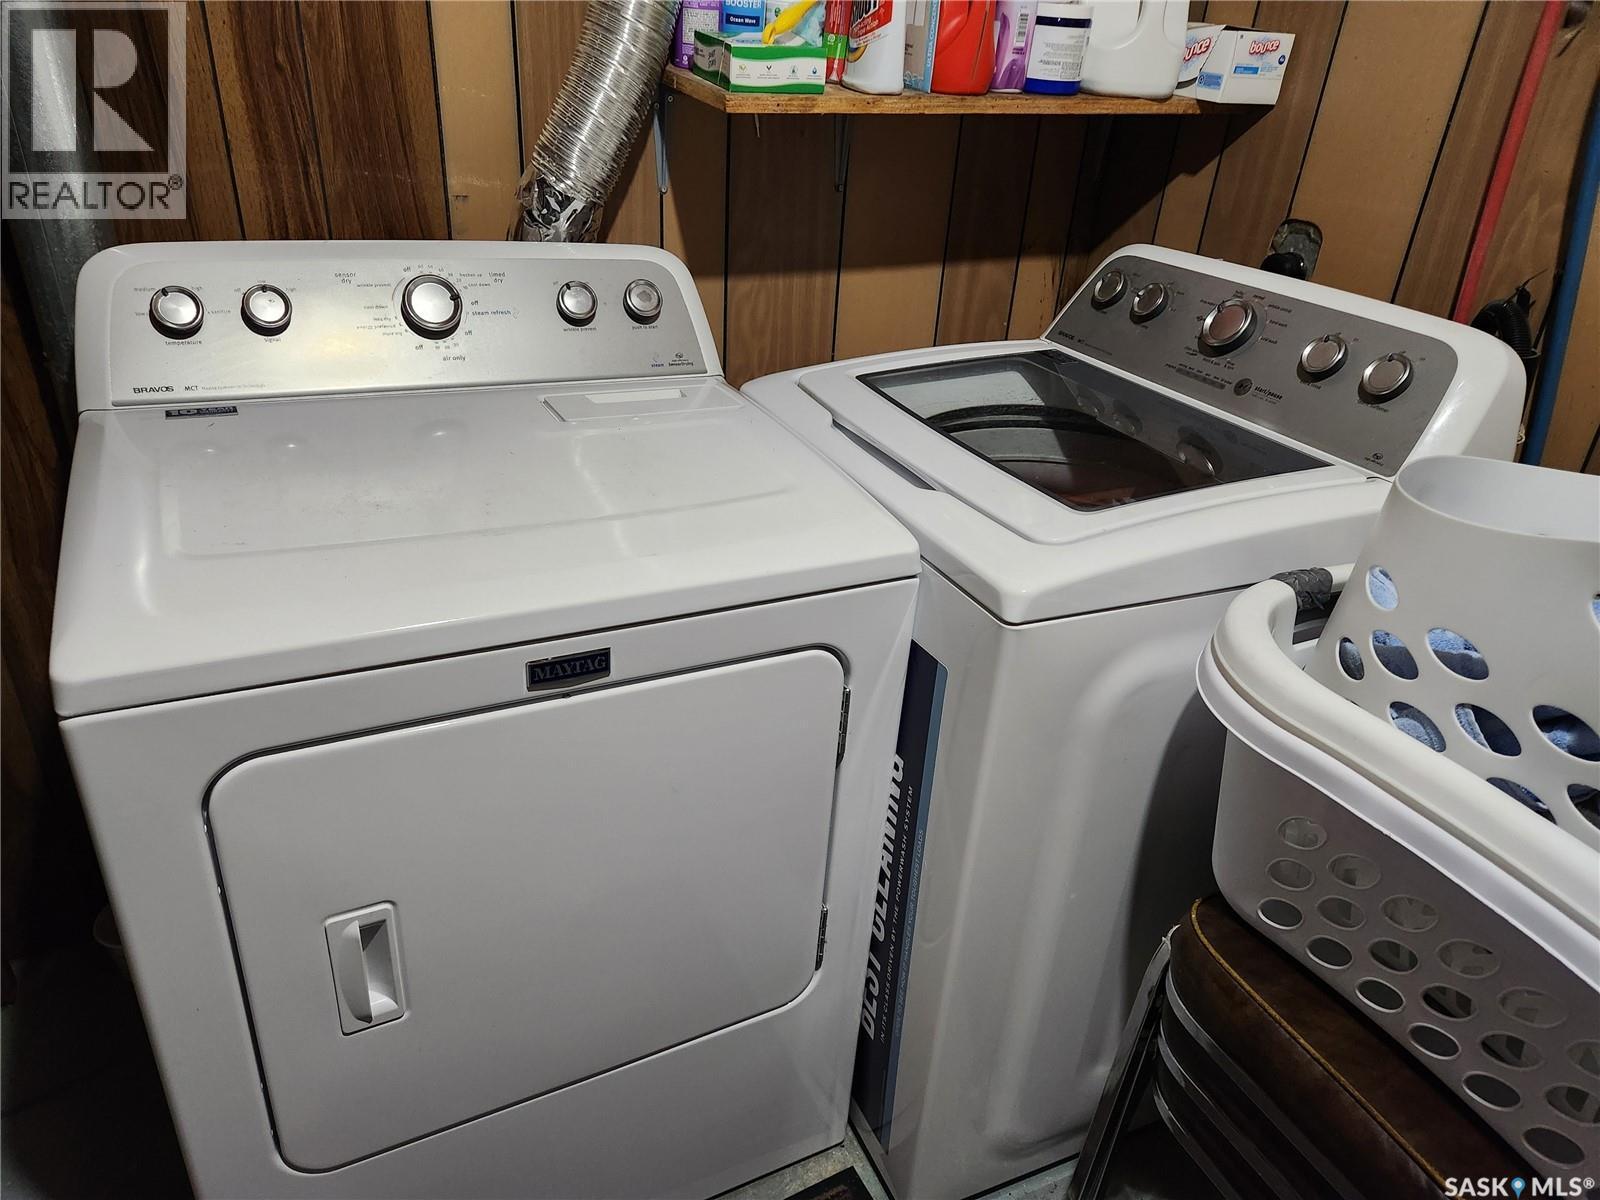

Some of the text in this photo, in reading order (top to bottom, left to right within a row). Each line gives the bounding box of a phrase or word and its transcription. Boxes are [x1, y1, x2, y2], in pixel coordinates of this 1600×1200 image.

[1183, 38, 1212, 61] unce
[1248, 39, 1281, 55] bounce
[164, 340, 203, 348] temperature
[452, 354, 466, 362] only
[132, 385, 175, 395] BRAVOS
[184, 384, 199, 392] MCT
[1254, 386, 1283, 400] start/pause
[532, 655, 607, 682] MAYTAG
[903, 785, 914, 832] SYSTEM
[915, 828, 924, 858] LOADS
[894, 833, 908, 902] POWERWASH
[909, 860, 920, 901] TOUGHEST
[891, 903, 901, 924] THE
[906, 902, 915, 924] YOUR
[890, 926, 897, 942] BY
[886, 943, 895, 980] DRIVEN
[883, 980, 892, 1013] CLASS
